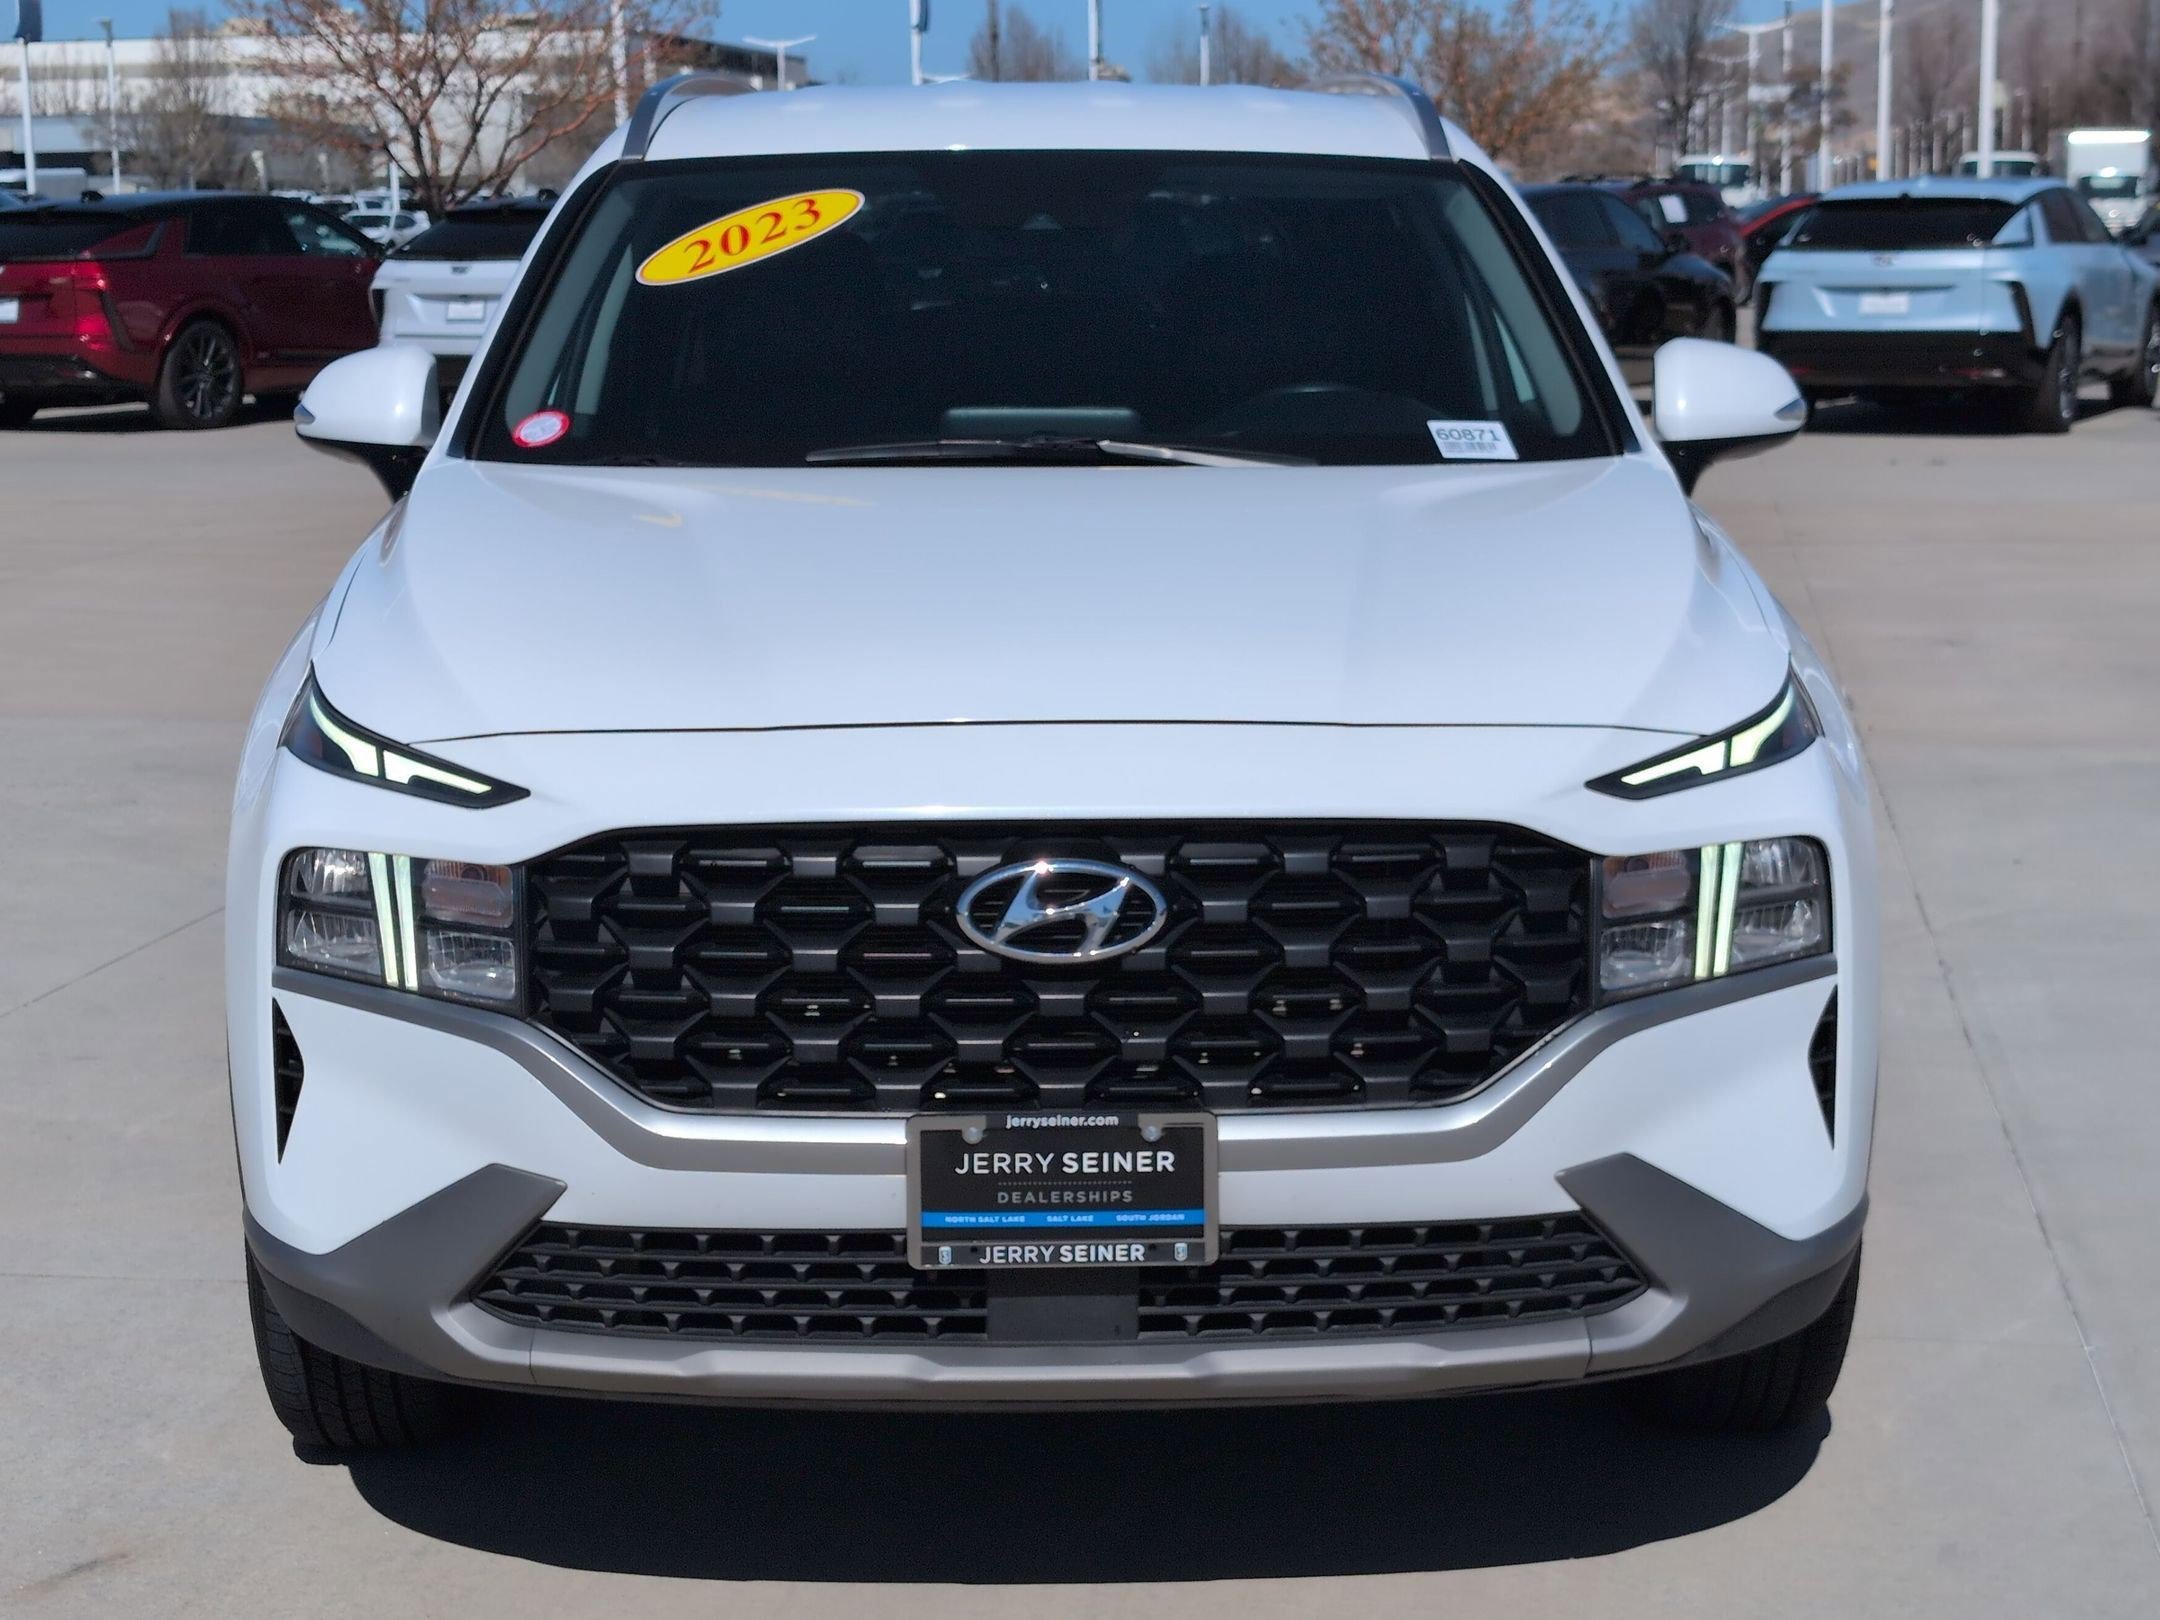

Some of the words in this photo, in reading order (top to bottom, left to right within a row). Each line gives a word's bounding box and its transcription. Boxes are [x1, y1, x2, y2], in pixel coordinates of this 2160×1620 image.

[683, 198, 821, 274] 2023
[1435, 428, 1501, 442] 60871
[1005, 1114, 1119, 1129] jerryseiner.com
[954, 1152, 1055, 1175] JERRY
[1062, 1151, 1175, 1174] SEINER
[997, 1190, 1134, 1204] DEALERSHIPS
[1001, 1215, 1026, 1223] LAKE
[1046, 1215, 1069, 1223] SALT
[1070, 1214, 1094, 1222] LAKE
[1116, 1214, 1147, 1222] SOUTH
[979, 1245, 1055, 1264] JERRY
[1059, 1244, 1145, 1263] SEINER
